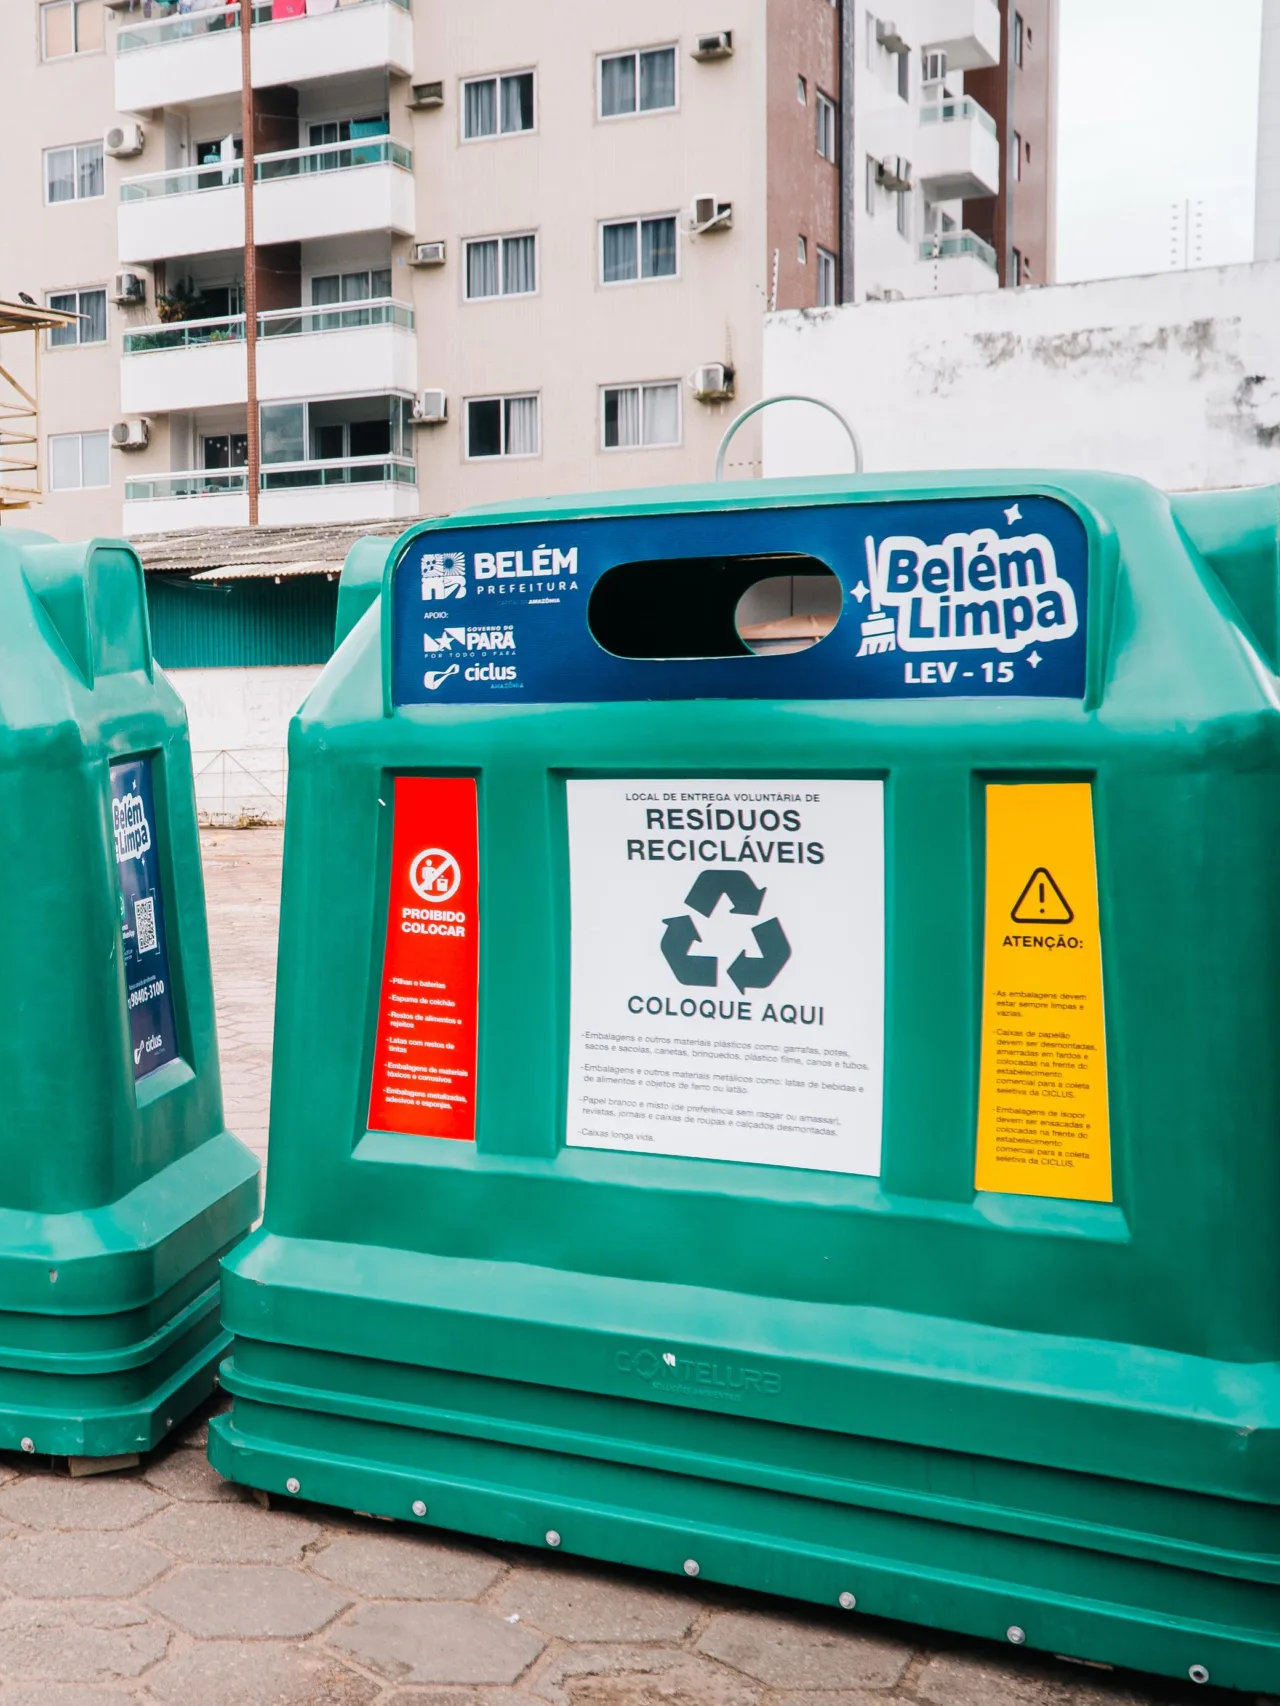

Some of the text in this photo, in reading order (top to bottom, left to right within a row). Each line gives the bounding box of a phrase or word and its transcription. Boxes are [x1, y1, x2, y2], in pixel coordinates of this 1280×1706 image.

[474, 544, 578, 580] BELÉM
[887, 542, 1046, 594] Belém
[477, 581, 578, 594] PREFEITURA
[909, 591, 1066, 640] Limpa
[464, 662, 517, 681] ciclus
[905, 662, 958, 684] LEV
[981, 662, 1014, 683] 15
[626, 792, 820, 802] LOCAL DE ENTREGA VOLUNTÁRIA DE
[114, 800, 142, 830] Belém
[646, 803, 801, 832] RESÍDUOS
[119, 824, 148, 854] Limpa
[627, 836, 825, 864] RECICLÁVEIS
[402, 908, 466, 922] PROIBIDO
[402, 922, 466, 938] COLOCAR
[1002, 934, 1084, 951] ATENÇÃO:
[628, 995, 824, 1026] COLOQUE AQUI
